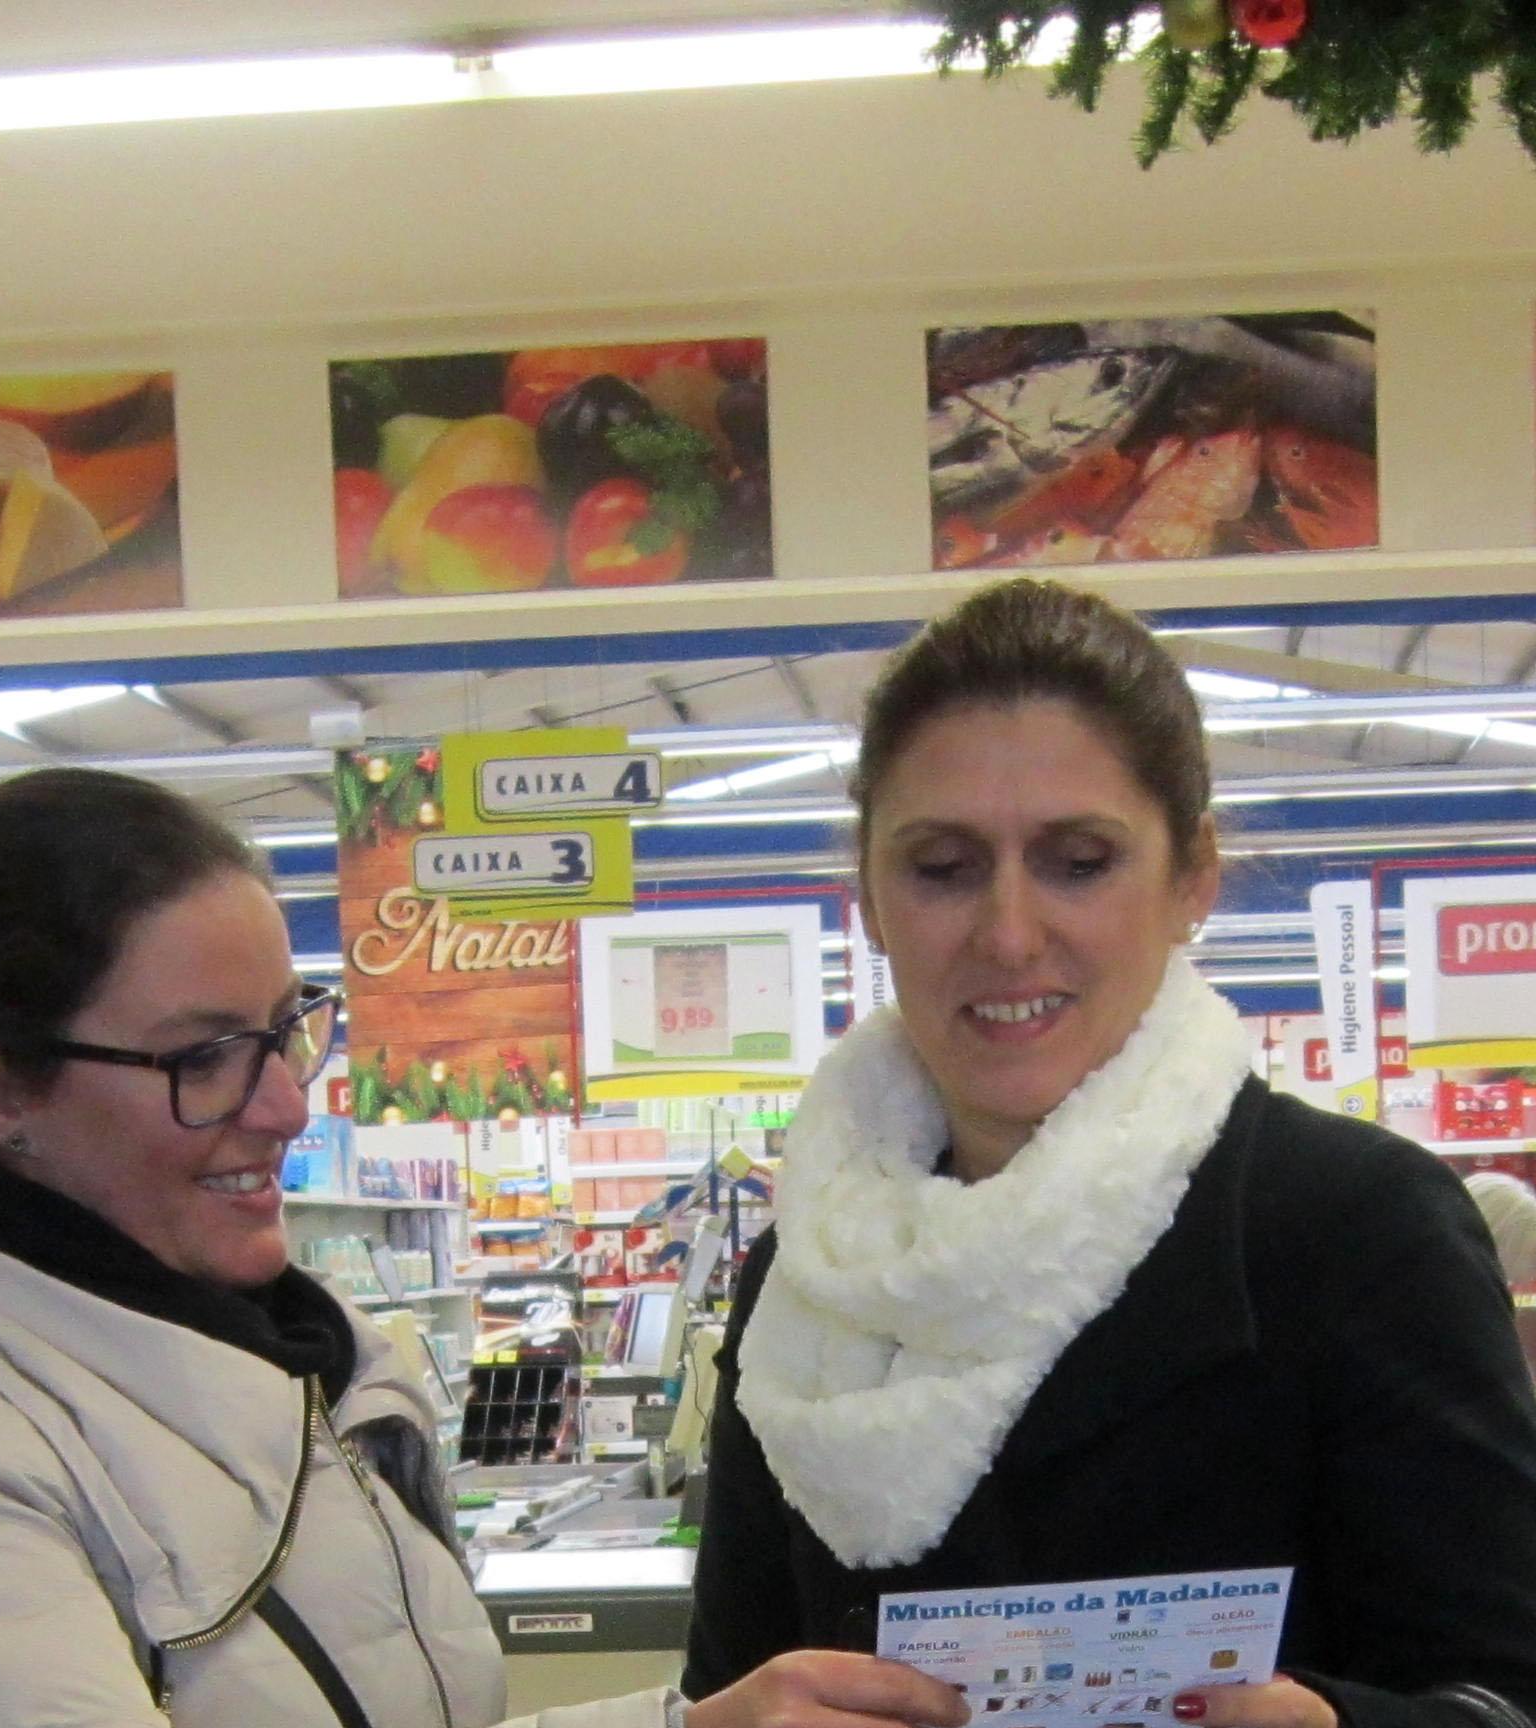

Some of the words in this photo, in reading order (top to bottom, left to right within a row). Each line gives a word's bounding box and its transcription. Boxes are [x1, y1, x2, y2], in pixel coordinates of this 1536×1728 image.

[495, 771, 586, 796] CAIXA
[613, 760, 652, 803] 4
[432, 850, 523, 874] CAIXA
[550, 838, 586, 883] 3
[352, 886, 572, 976] Natal
[1336, 904, 1355, 974] Pessoal
[1341, 978, 1362, 1054] Higiene
[884, 1596, 1056, 1621] Município
[1065, 1593, 1105, 1612] da
[1115, 1581, 1280, 1608] Madalena
[897, 1639, 960, 1652] PAPELÃO
